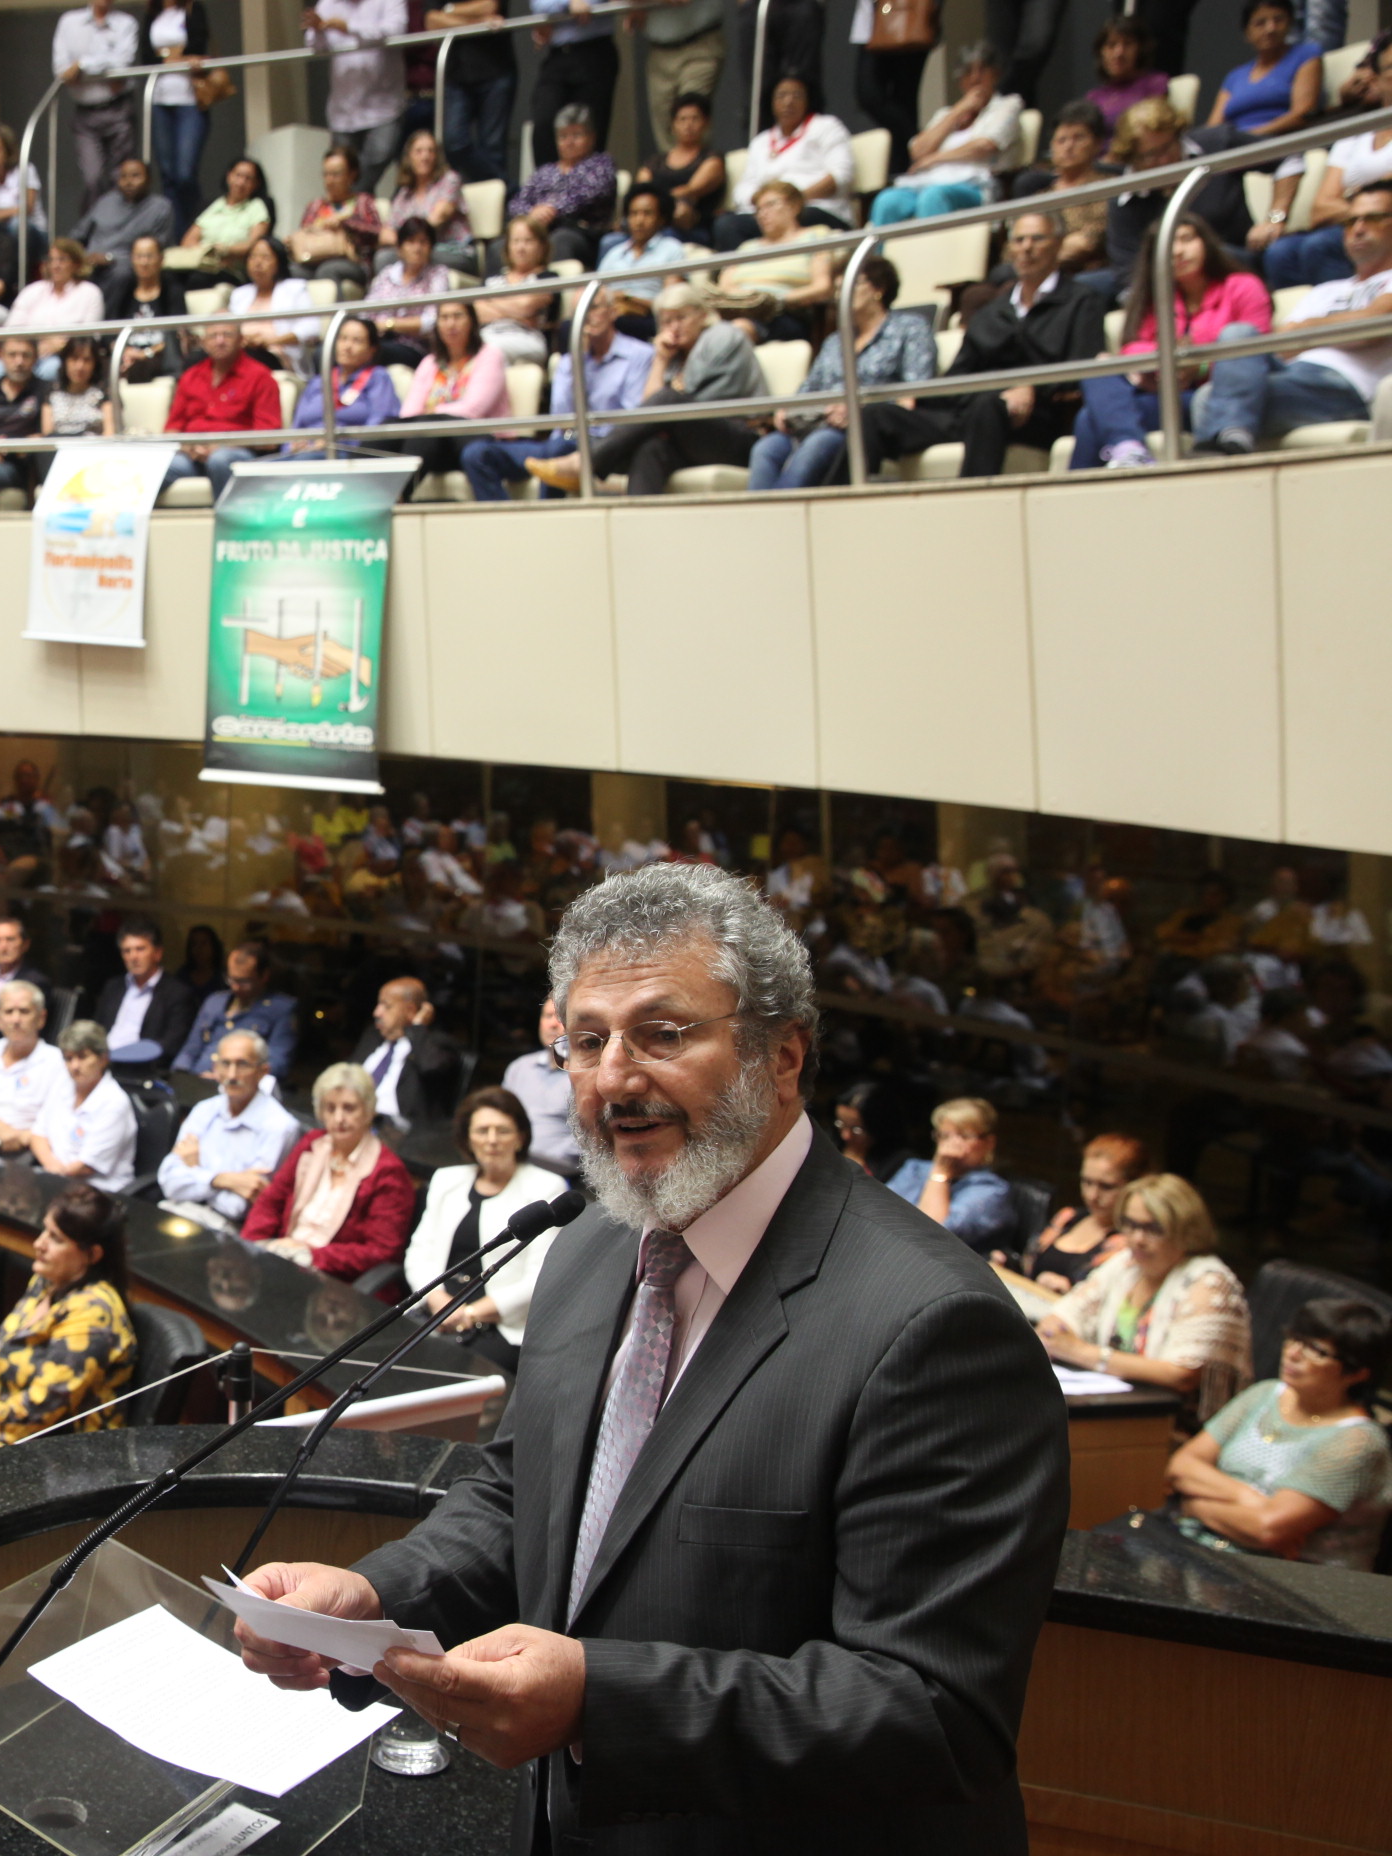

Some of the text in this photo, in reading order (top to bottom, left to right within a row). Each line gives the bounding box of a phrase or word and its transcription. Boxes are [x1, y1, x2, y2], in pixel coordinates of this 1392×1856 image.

[215, 538, 389, 567] FRUTO DA JUSTIÇA
[232, 1818, 268, 1845] JUNTOS
